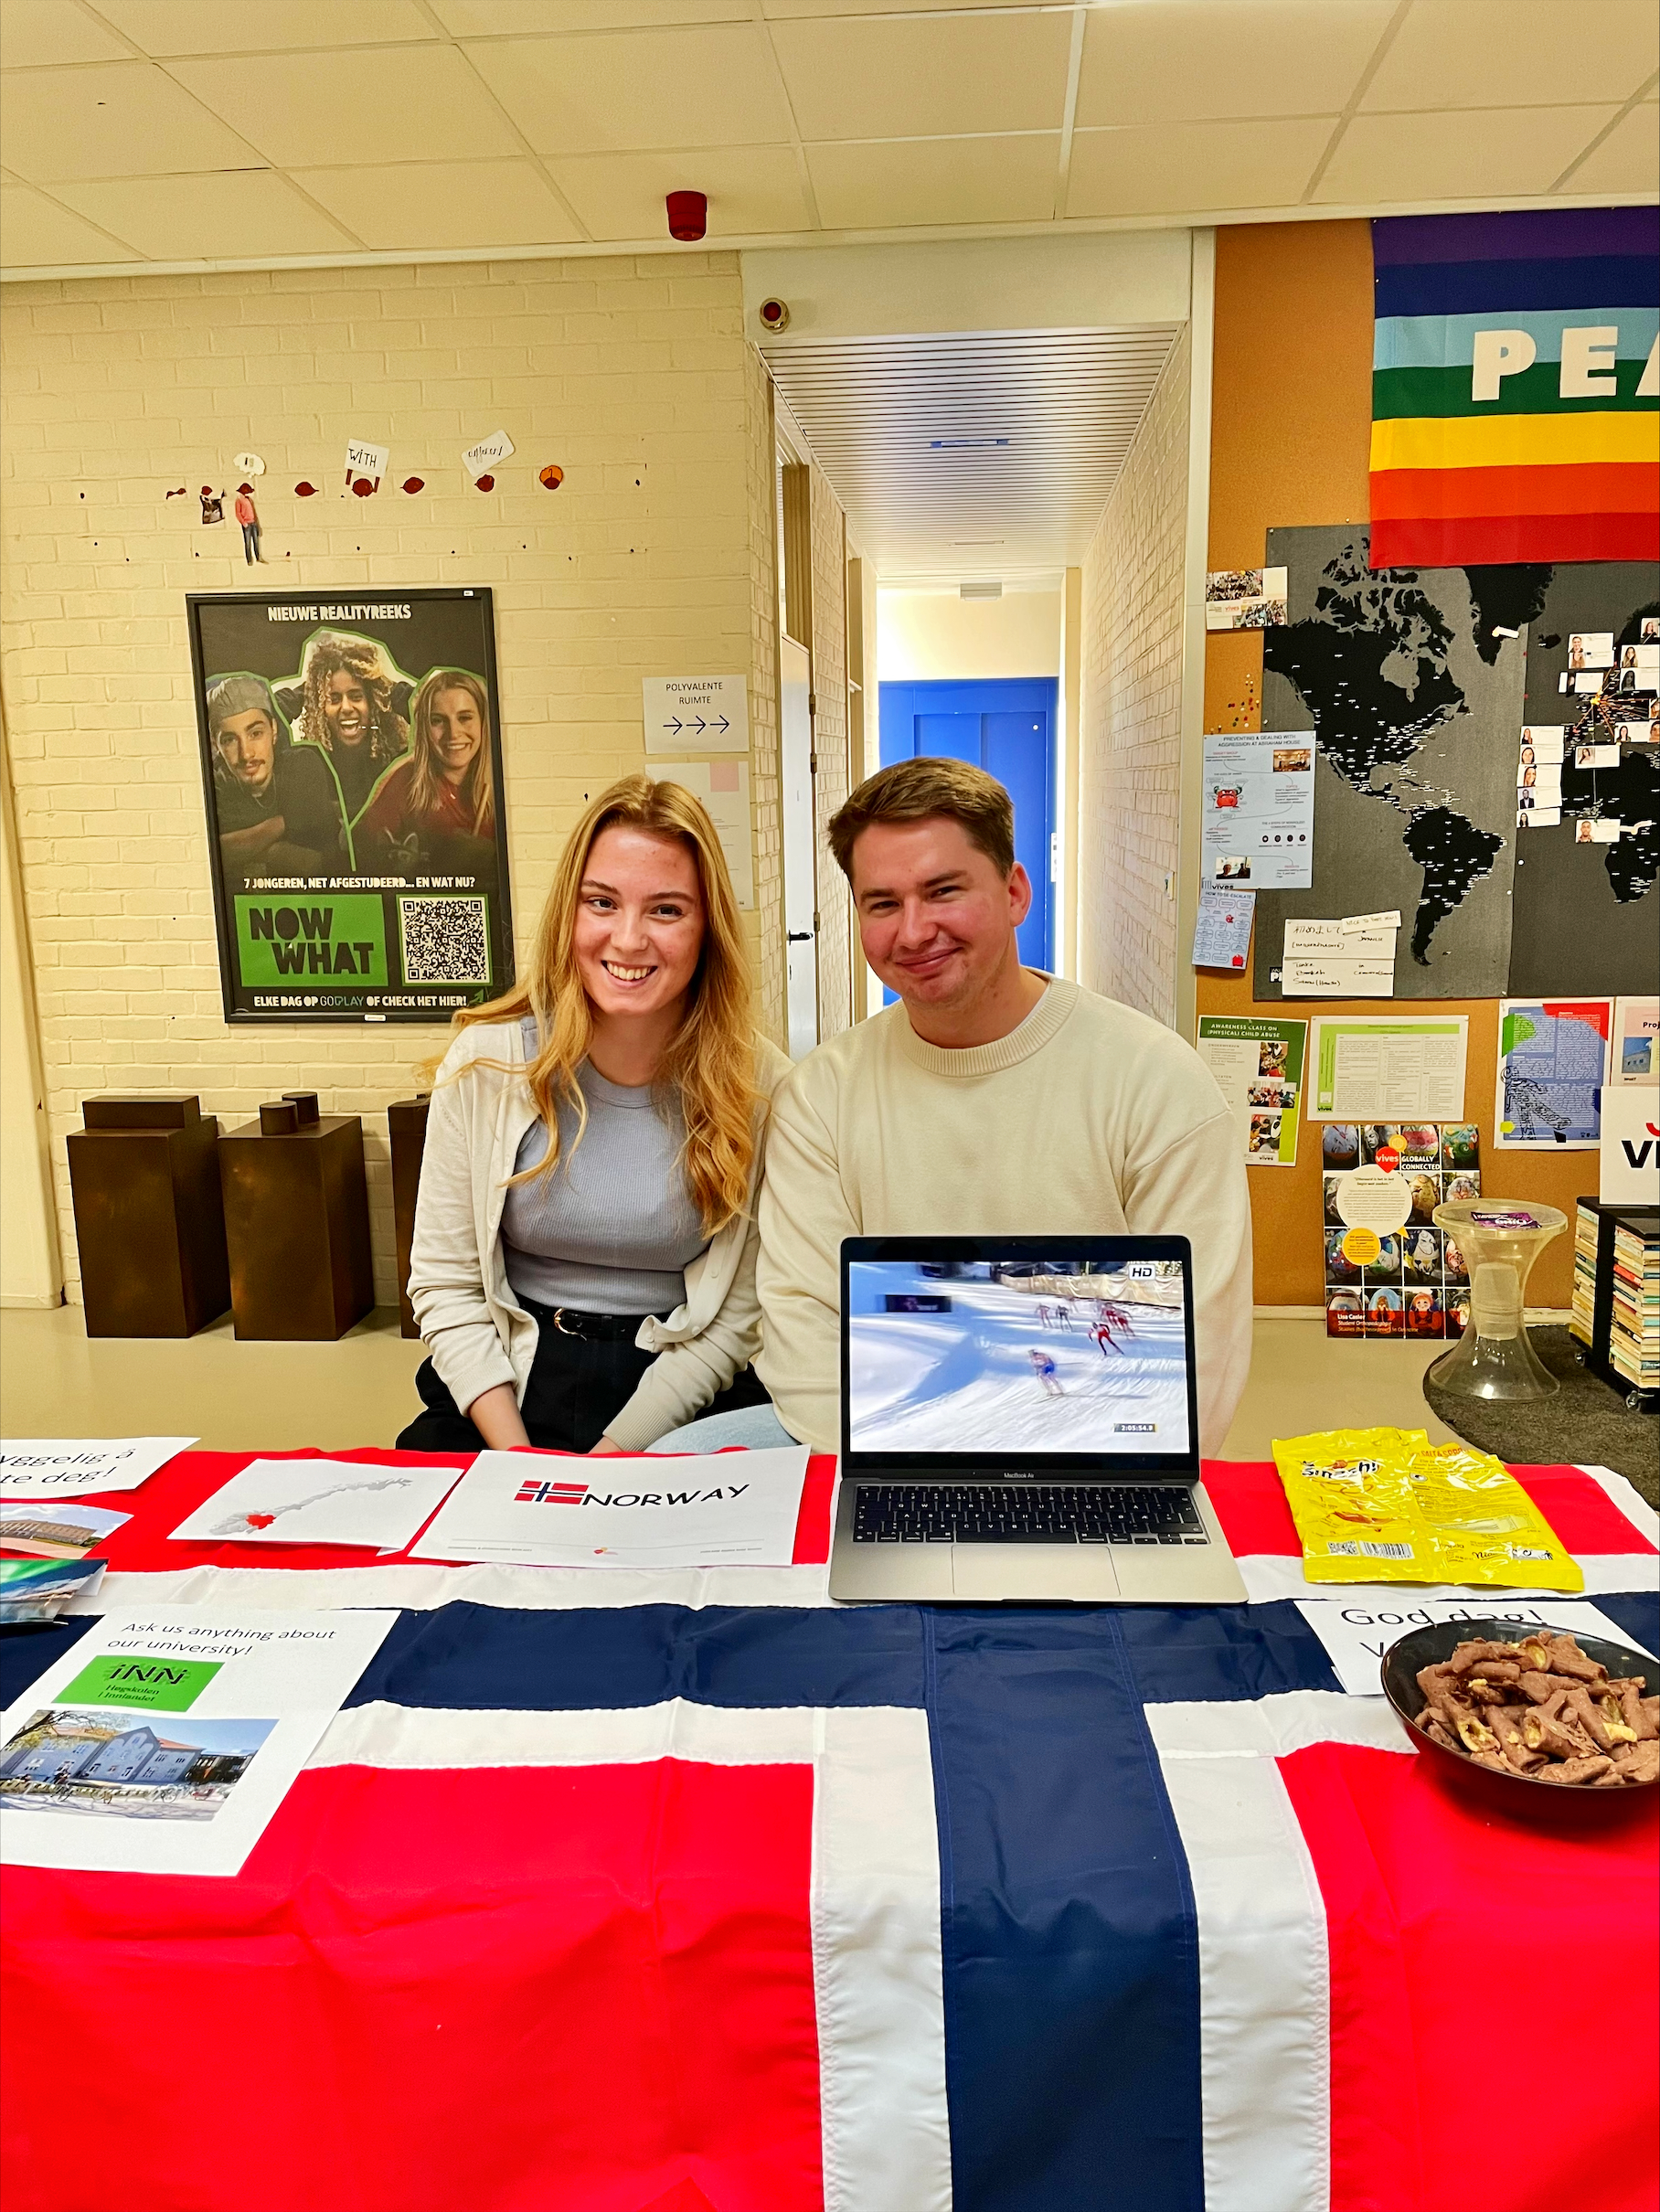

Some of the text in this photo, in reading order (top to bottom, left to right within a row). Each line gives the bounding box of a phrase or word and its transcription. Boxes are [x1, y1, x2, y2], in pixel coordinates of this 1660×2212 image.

[267, 604, 412, 622] NIEUWE REALITYREEKS
[665, 681, 723, 692] POLYVALENTE
[678, 696, 711, 705] RUIMTE
[243, 877, 476, 890] 7 JONGEREN, NET AFGESTUDEERD... EN WAT NU?
[249, 907, 334, 941] NOW
[271, 941, 374, 974] WHAT
[253, 995, 280, 1007] ELKE
[280, 995, 303, 1007] DAG
[303, 995, 319, 1007] OP
[366, 995, 380, 1007] OF
[381, 995, 416, 1006] CHECK
[417, 995, 438, 1006] HET
[438, 995, 467, 1006] HIER!
[1376, 1154, 1399, 1163] vives
[1133, 1268, 1152, 1277] HD
[115, 1448, 136, 1459] å
[41, 1466, 118, 1484] deg!
[581, 1484, 750, 1506] NORWAY
[1340, 1608, 1436, 1625] God
[121, 1622, 336, 1642] Ask us anything about
[107, 1639, 253, 1656] our university!
